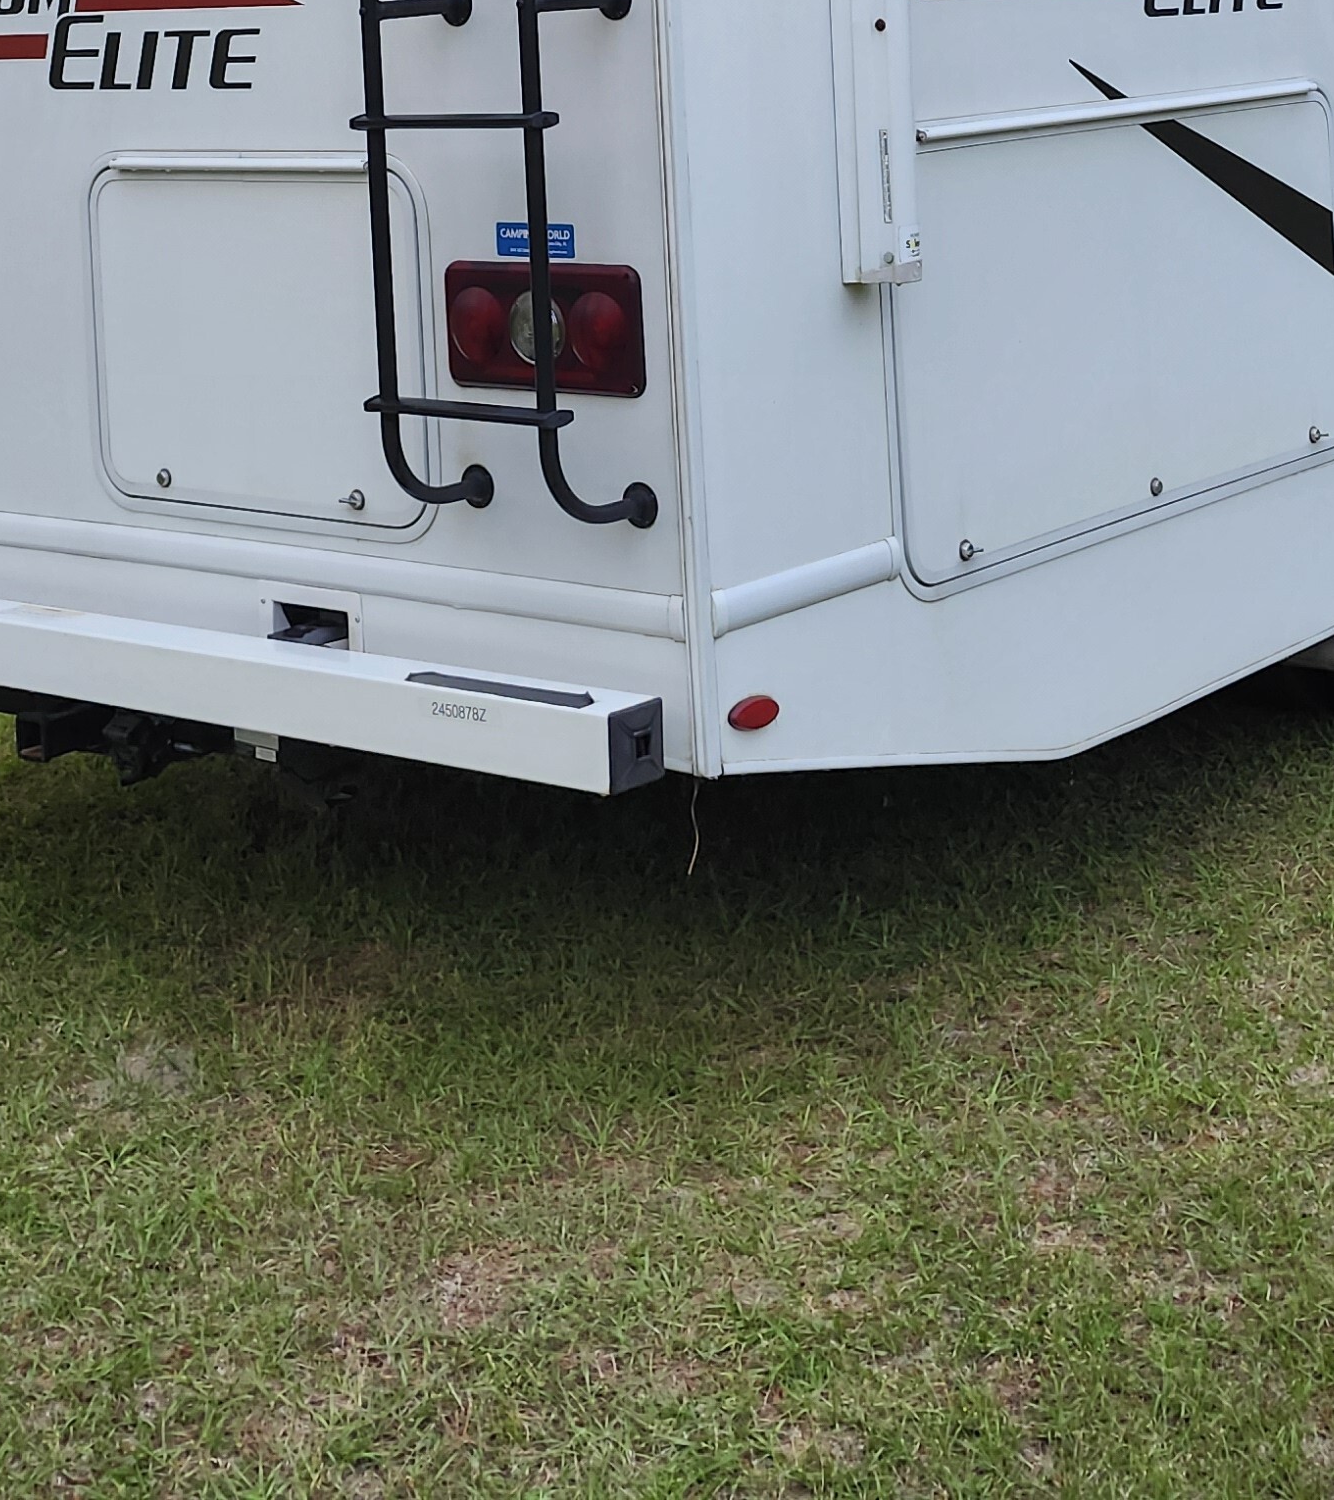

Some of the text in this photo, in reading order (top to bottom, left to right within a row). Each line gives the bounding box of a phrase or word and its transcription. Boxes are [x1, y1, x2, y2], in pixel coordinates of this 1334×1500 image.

[48, 14, 261, 91] ELITE
[499, 227, 571, 240] CAMPI ORLD
[431, 701, 487, 722] 2450878Z
